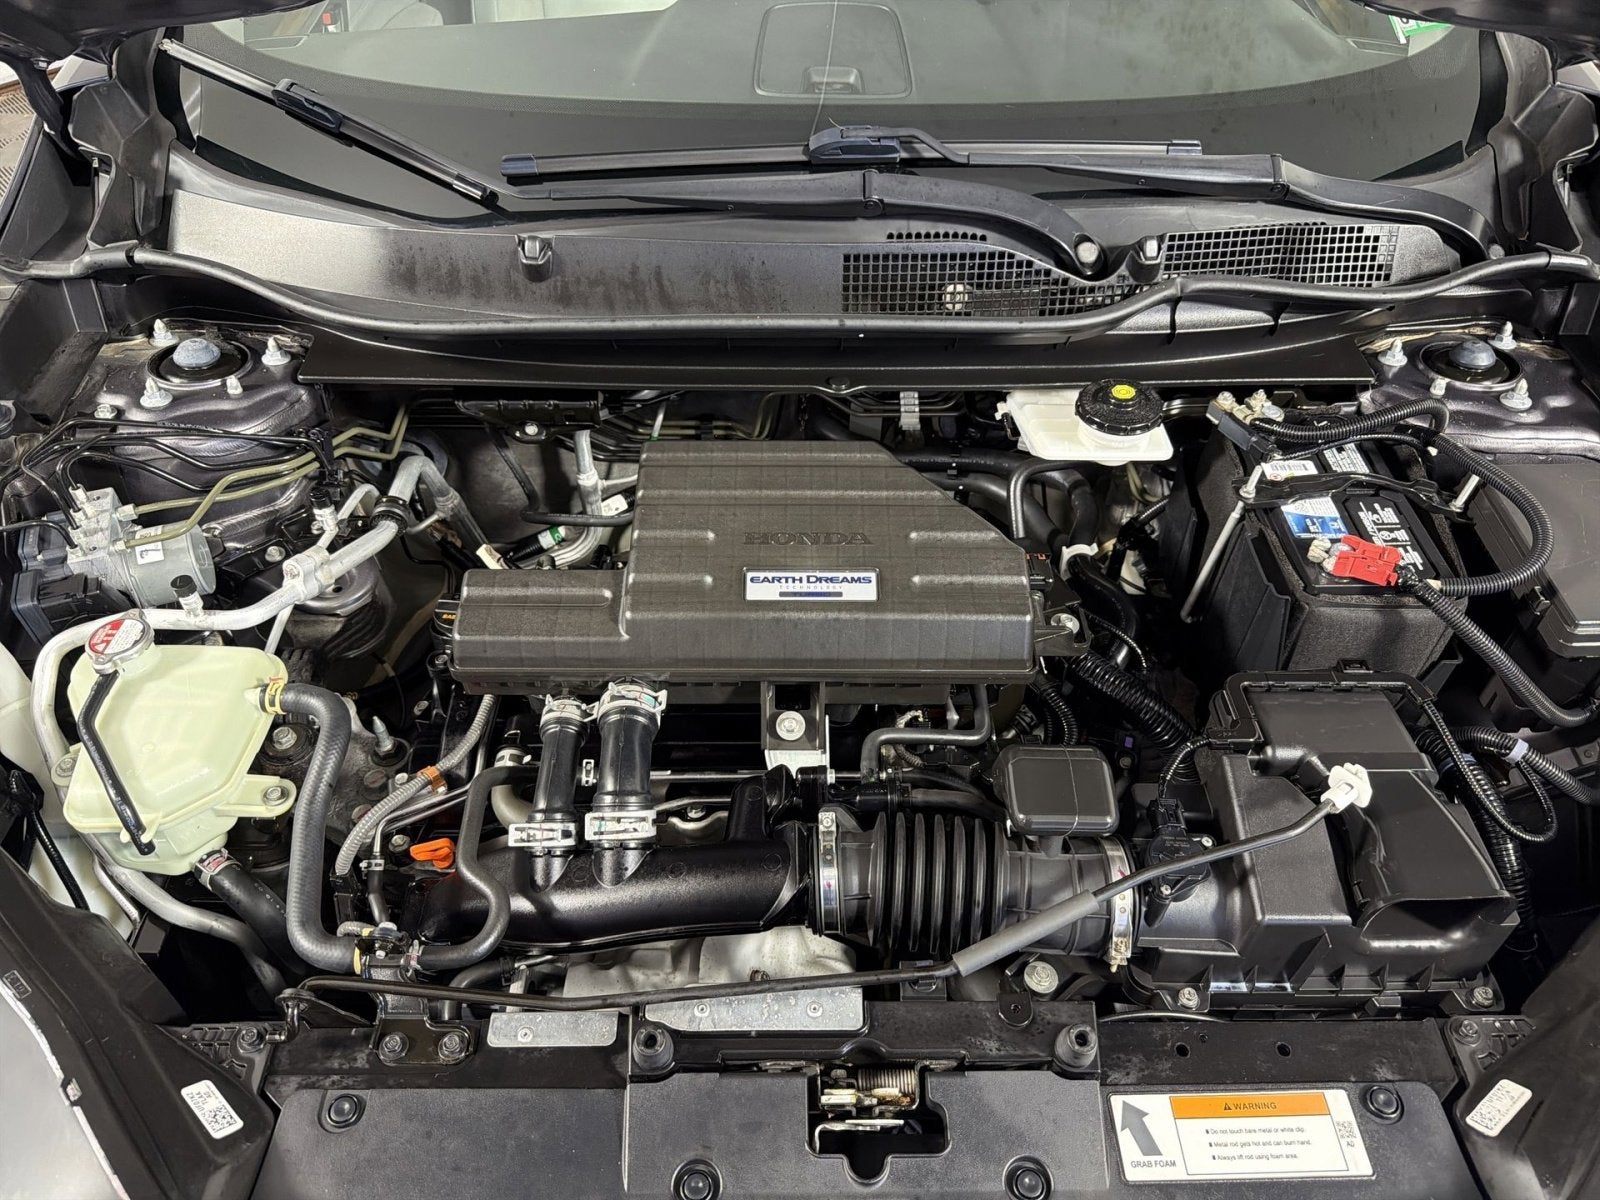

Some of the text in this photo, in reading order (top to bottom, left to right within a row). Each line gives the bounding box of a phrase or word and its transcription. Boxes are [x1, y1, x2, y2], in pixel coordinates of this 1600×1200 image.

[742, 531, 875, 546] HONDA
[749, 574, 872, 584] EARTH DREAMS
[1233, 1102, 1277, 1111] WARNING
[1130, 1160, 1177, 1168] GRAB FOAM
